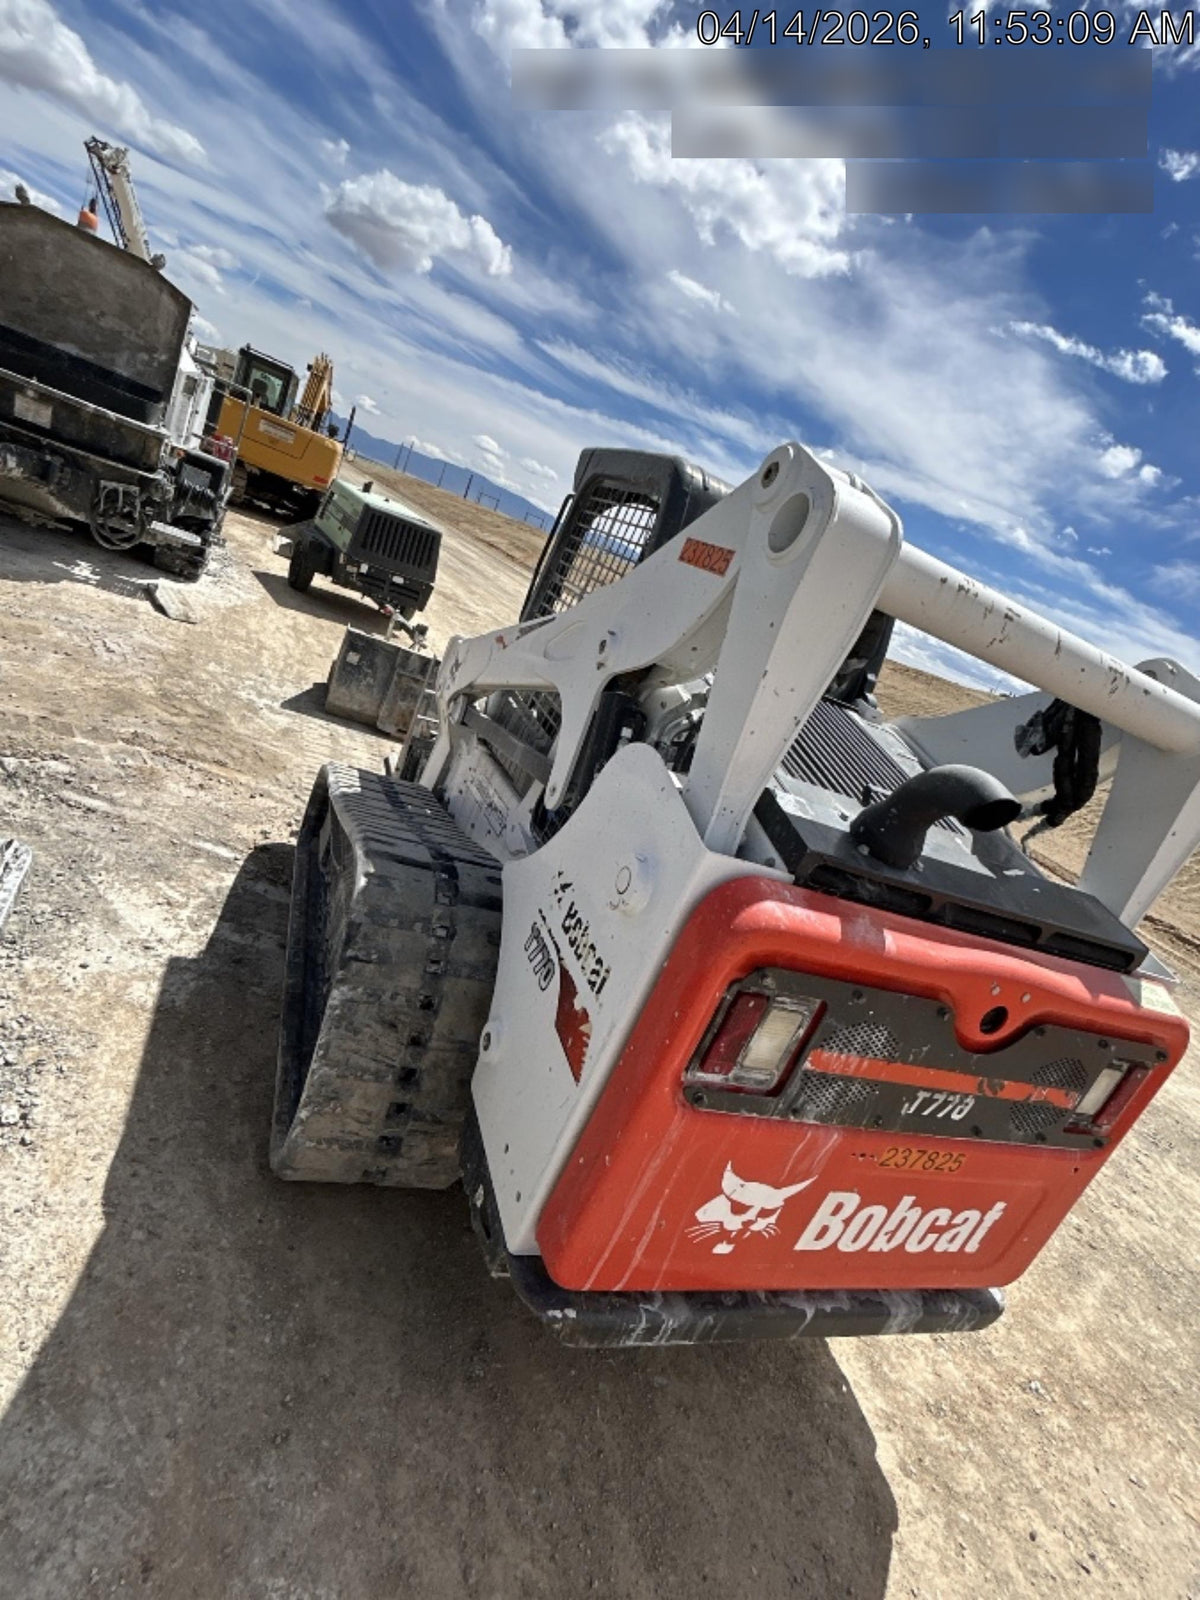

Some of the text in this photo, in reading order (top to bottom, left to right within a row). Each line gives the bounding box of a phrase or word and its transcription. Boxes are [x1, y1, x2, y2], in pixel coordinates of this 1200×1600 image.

[679, 538, 735, 577] 237825
[879, 1147, 966, 1172] 237825
[793, 1191, 1007, 1253] Bobcat
